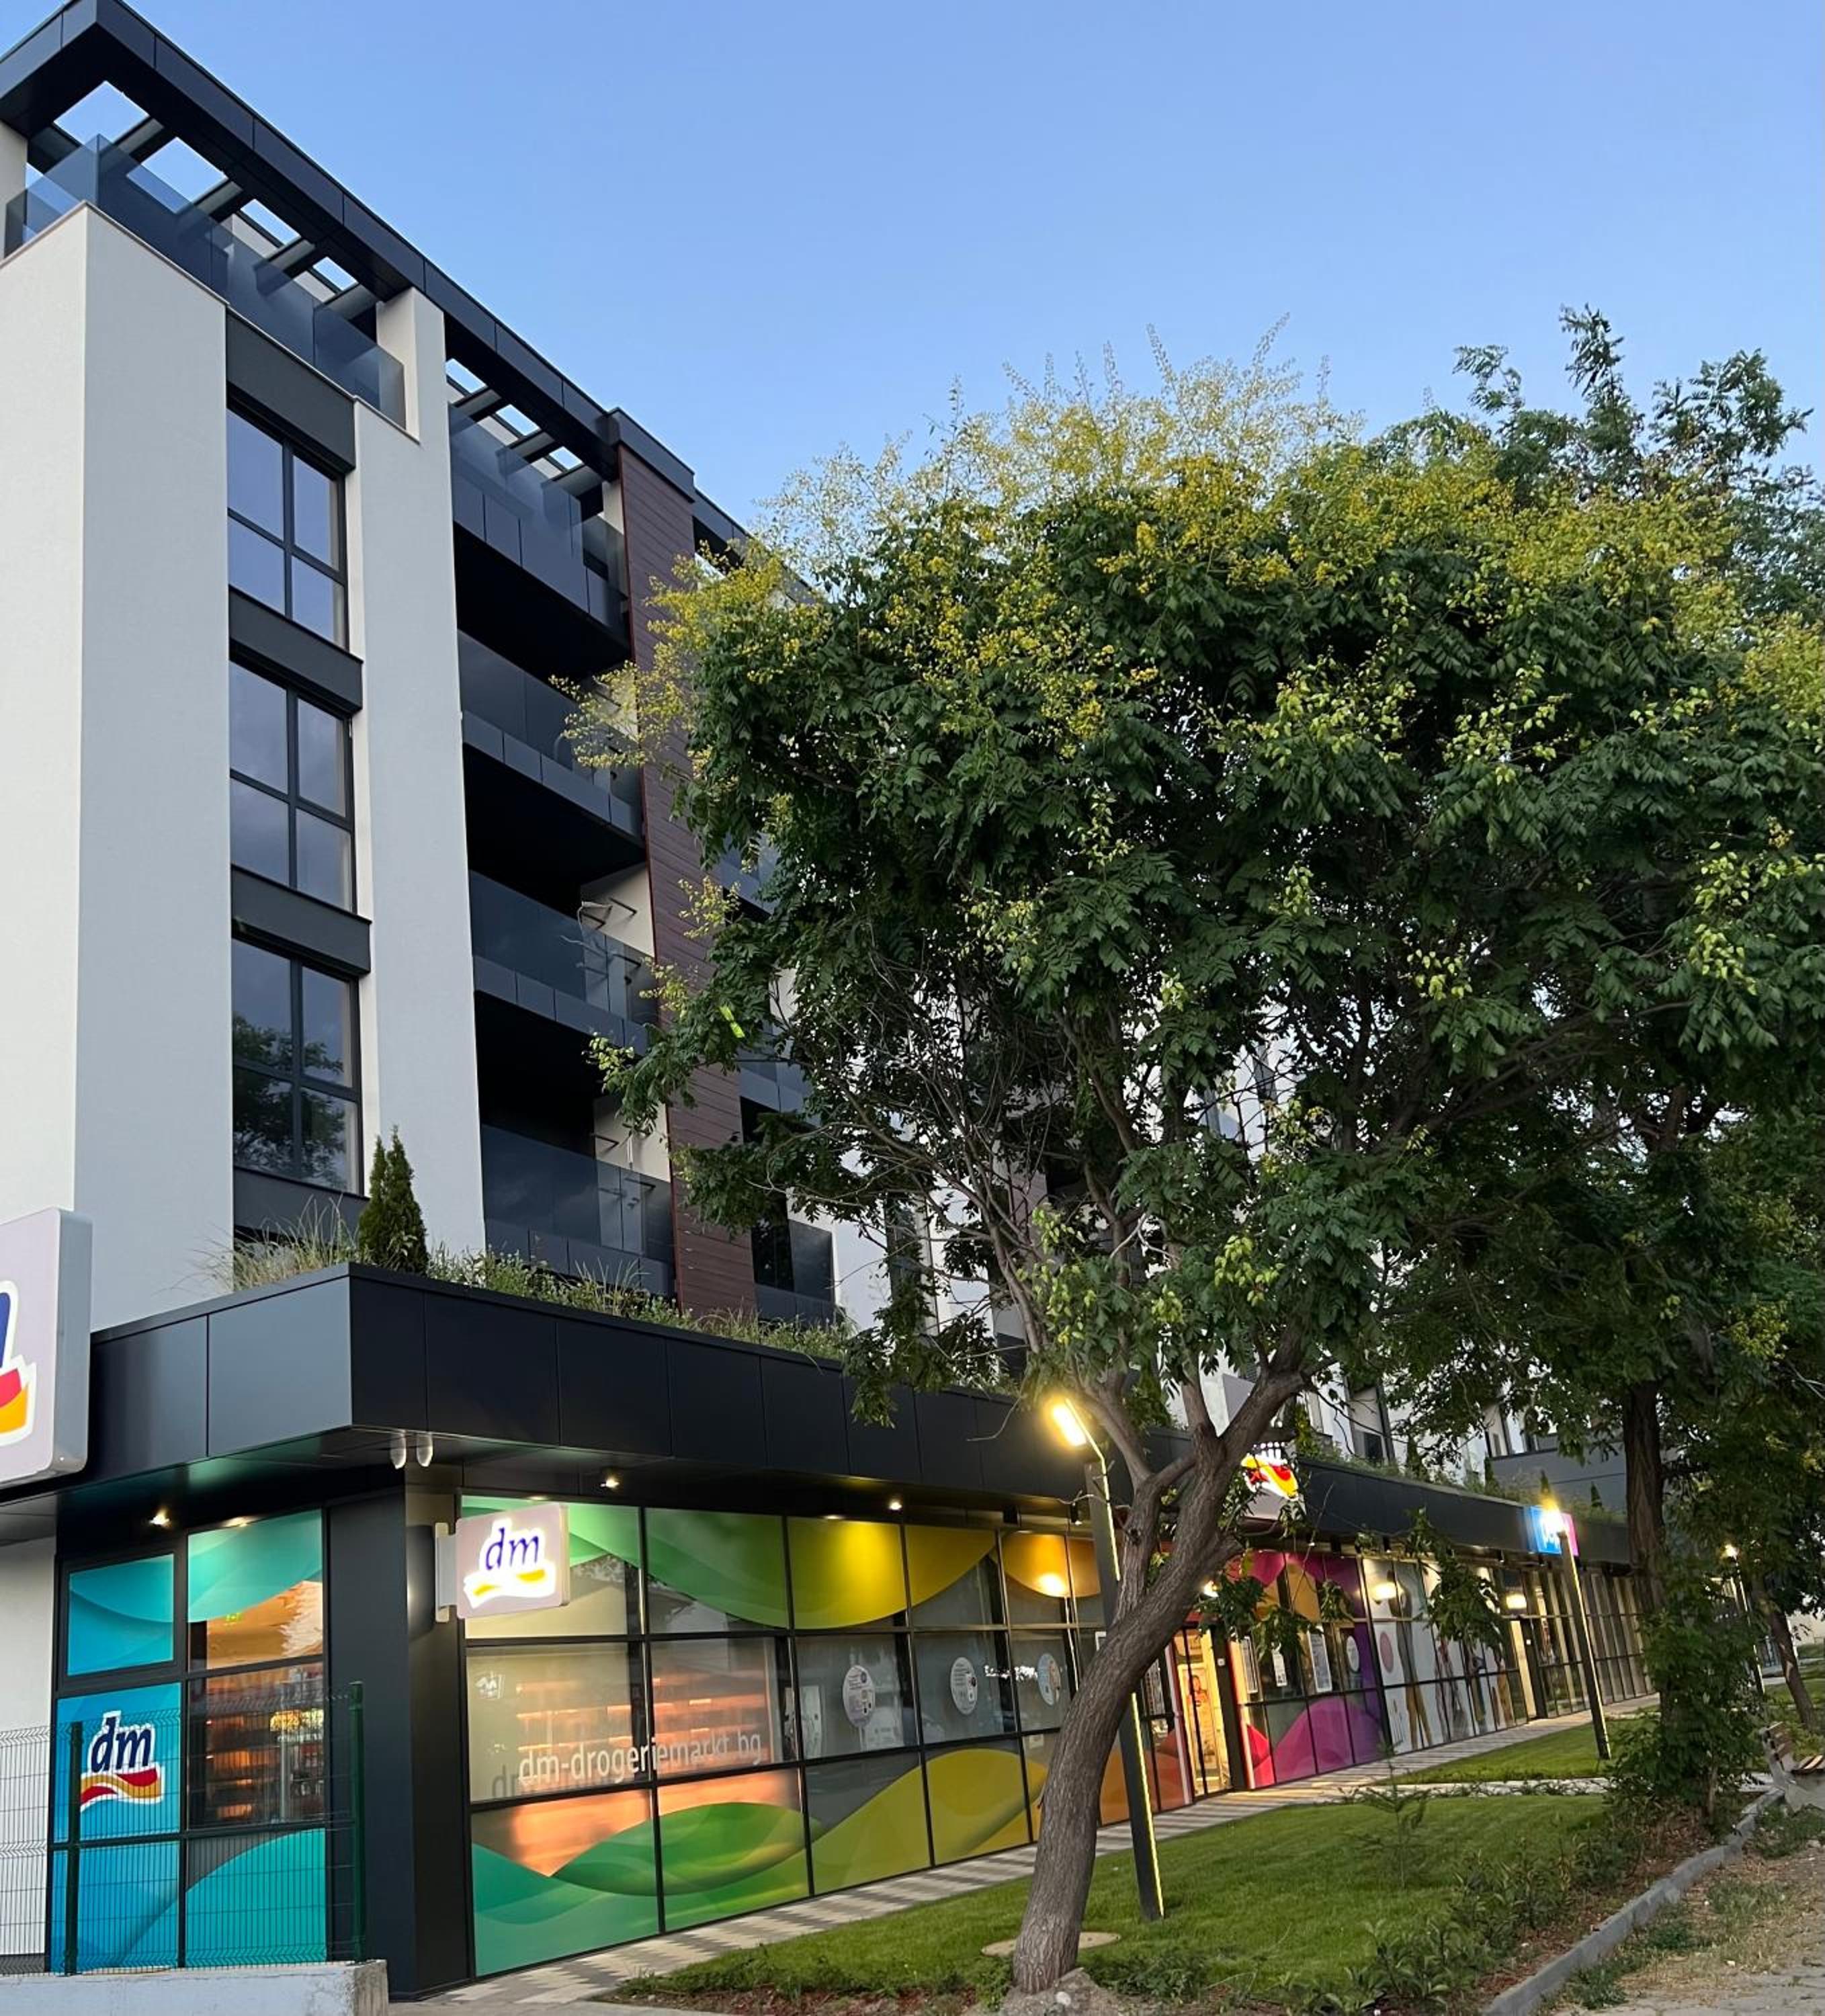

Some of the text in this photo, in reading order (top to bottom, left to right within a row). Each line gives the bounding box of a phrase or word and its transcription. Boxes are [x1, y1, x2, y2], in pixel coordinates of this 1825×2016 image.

[486, 1526, 540, 1571] dm
[91, 1716, 152, 1773] dm
[519, 1729, 761, 1785] dm-drogeriemarktbg
